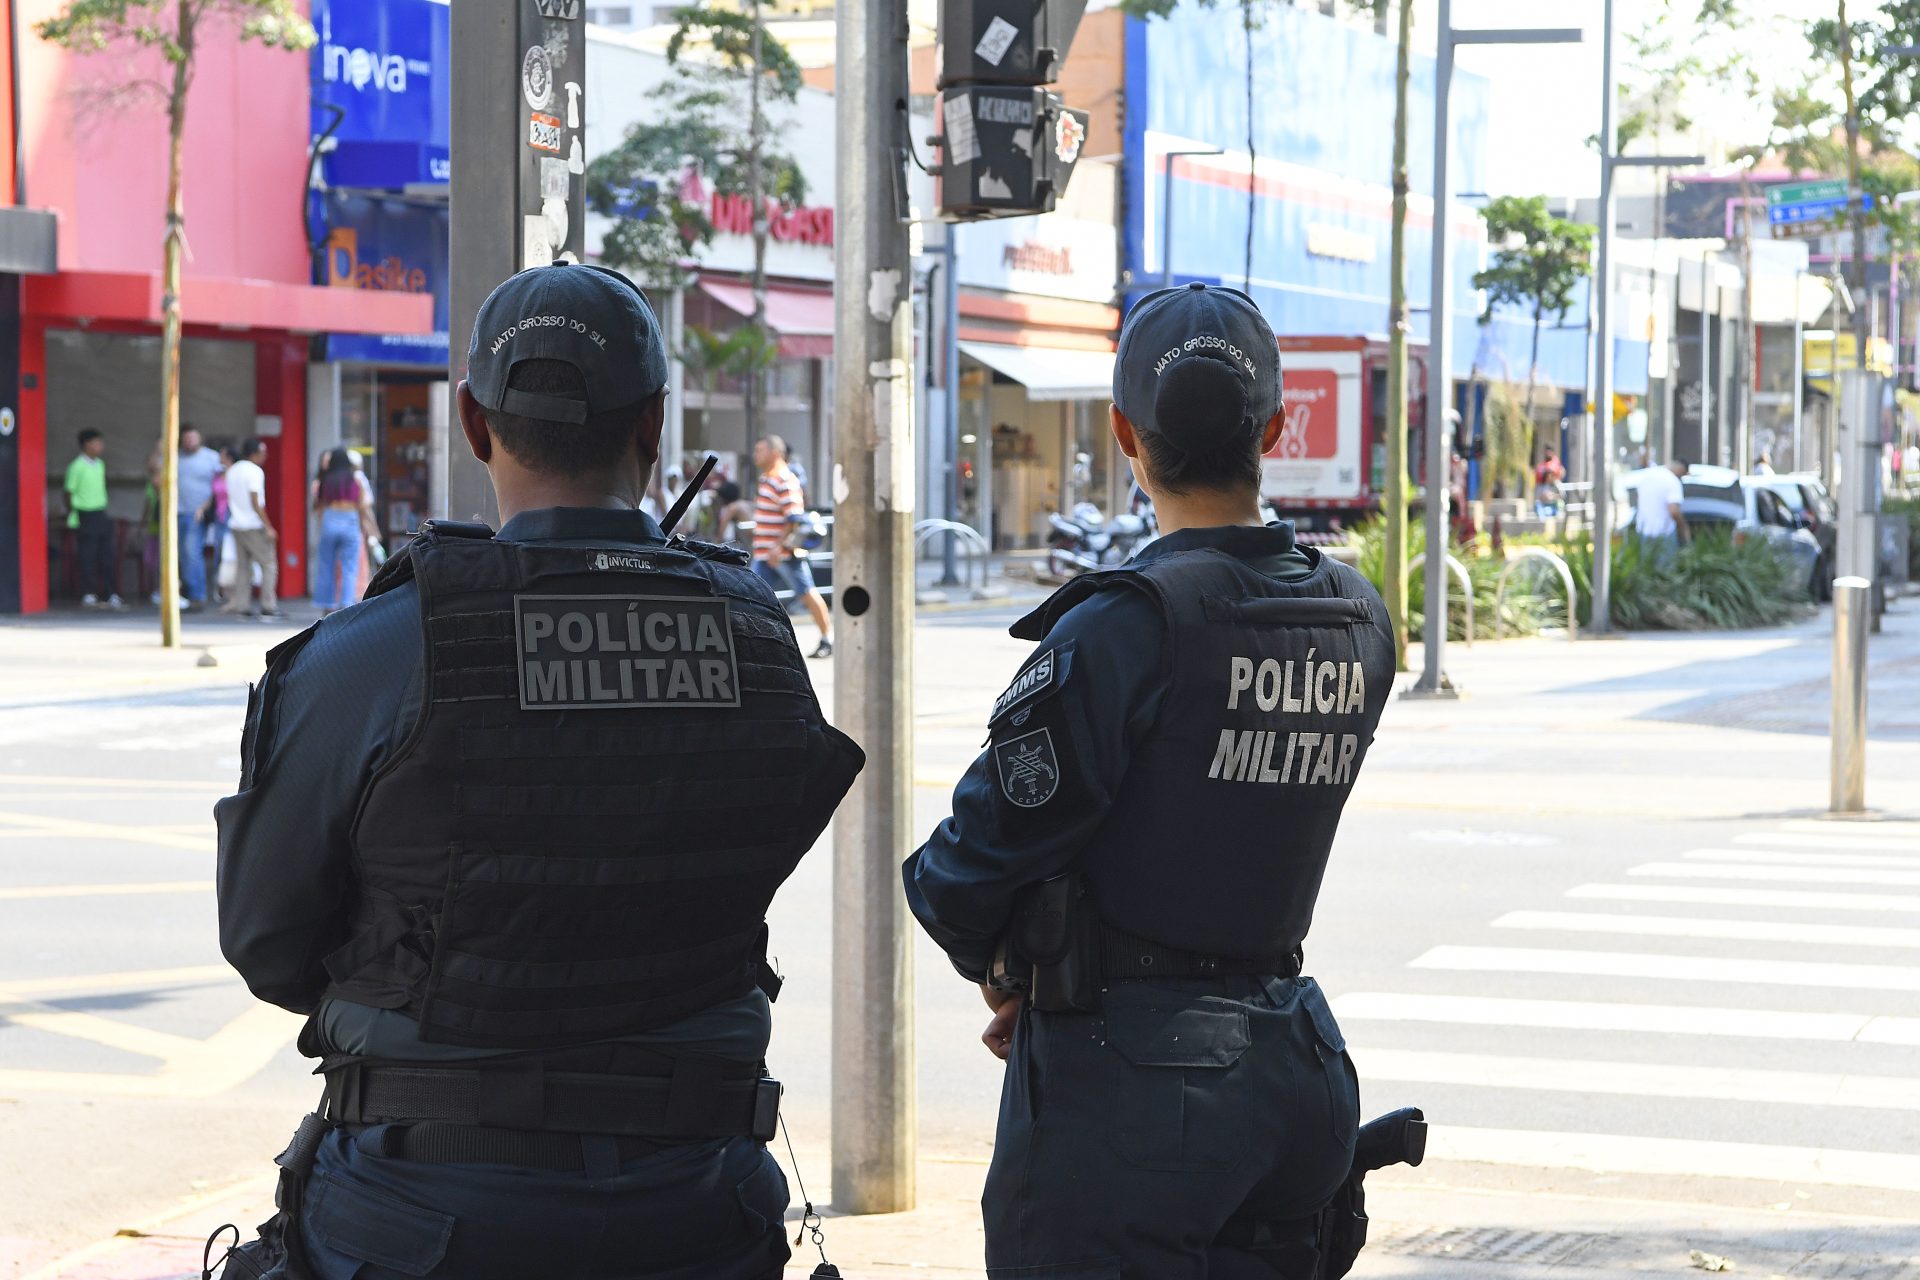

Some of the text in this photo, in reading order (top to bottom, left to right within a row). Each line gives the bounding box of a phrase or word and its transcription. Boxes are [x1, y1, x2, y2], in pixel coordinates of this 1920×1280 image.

[490, 316, 607, 355] MATO GROSSO DO SUL
[1153, 336, 1257, 380] MATO GROSSO DO SUL
[608, 556, 651, 570] INVICTUS
[524, 602, 728, 653] POLÍCIA
[526, 659, 733, 701] MILITAR
[1227, 647, 1365, 715] POLÍCIA
[1207, 728, 1358, 785] MILITAR
